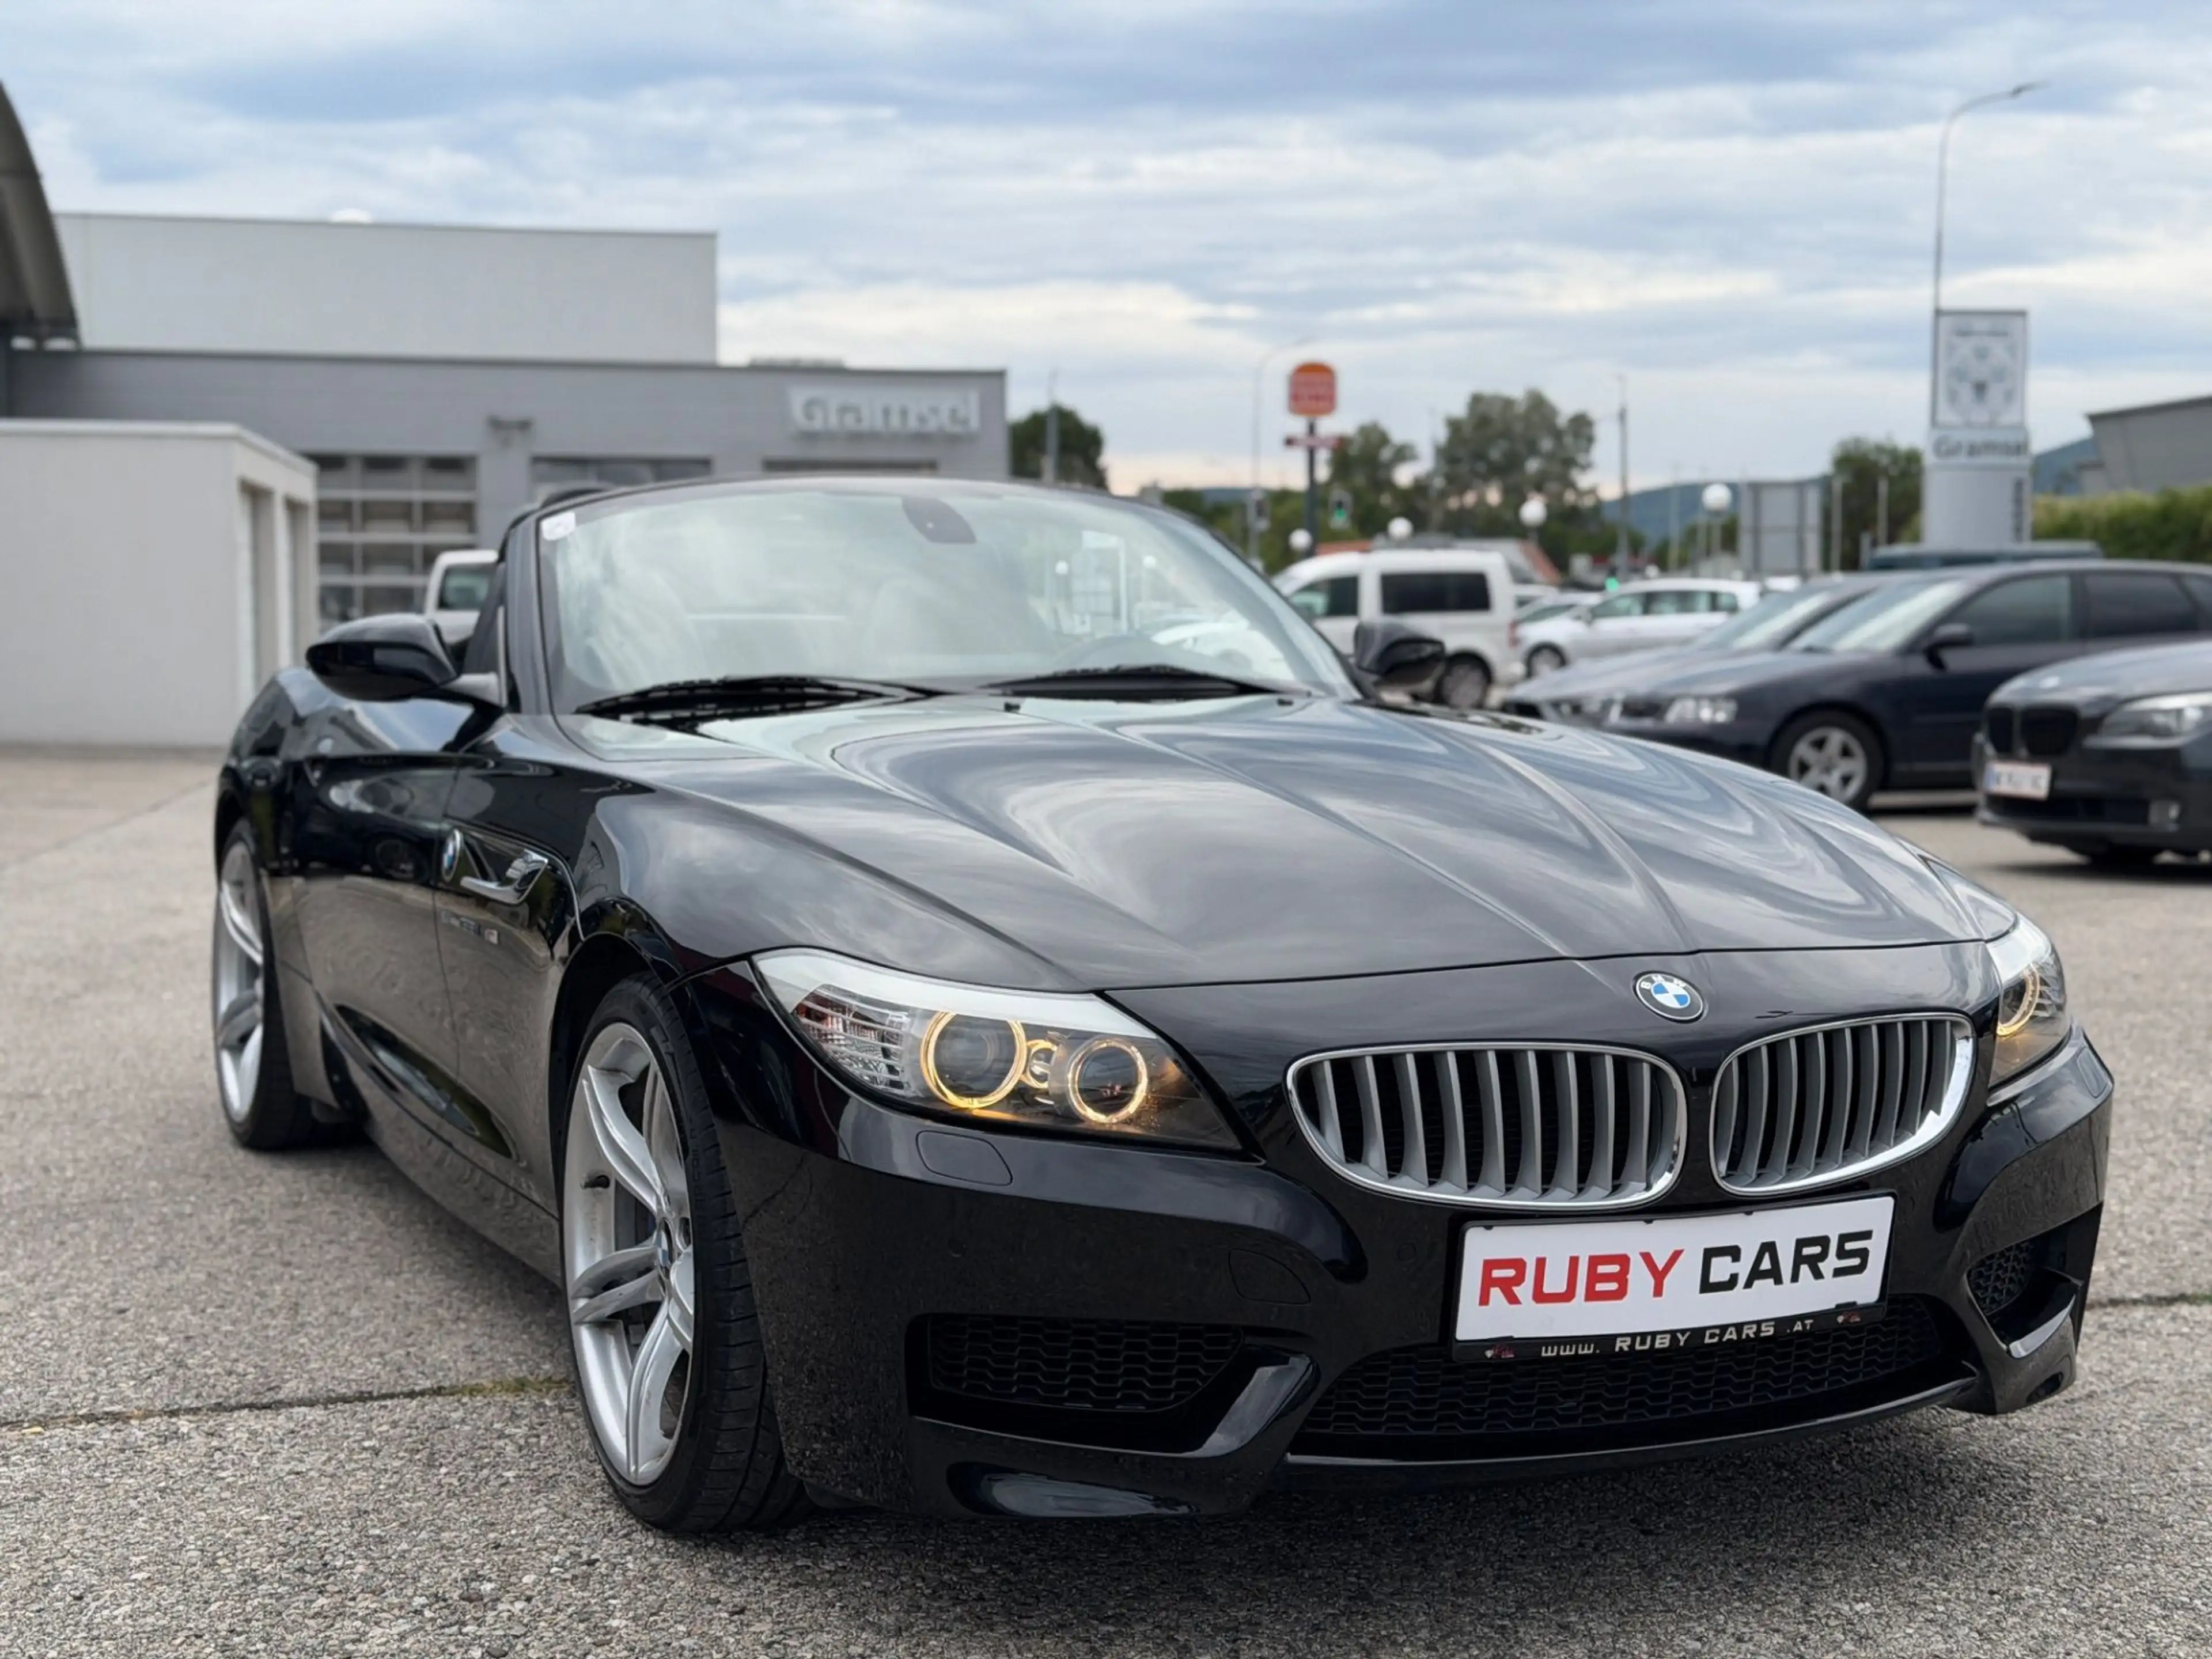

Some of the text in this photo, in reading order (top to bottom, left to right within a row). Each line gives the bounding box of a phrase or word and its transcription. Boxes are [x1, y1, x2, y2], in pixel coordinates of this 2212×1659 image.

[1478, 1229, 1874, 1306] RUBY CARS
[1614, 1331, 1691, 1352] RUBY
[1703, 1321, 1775, 1344] CARS
